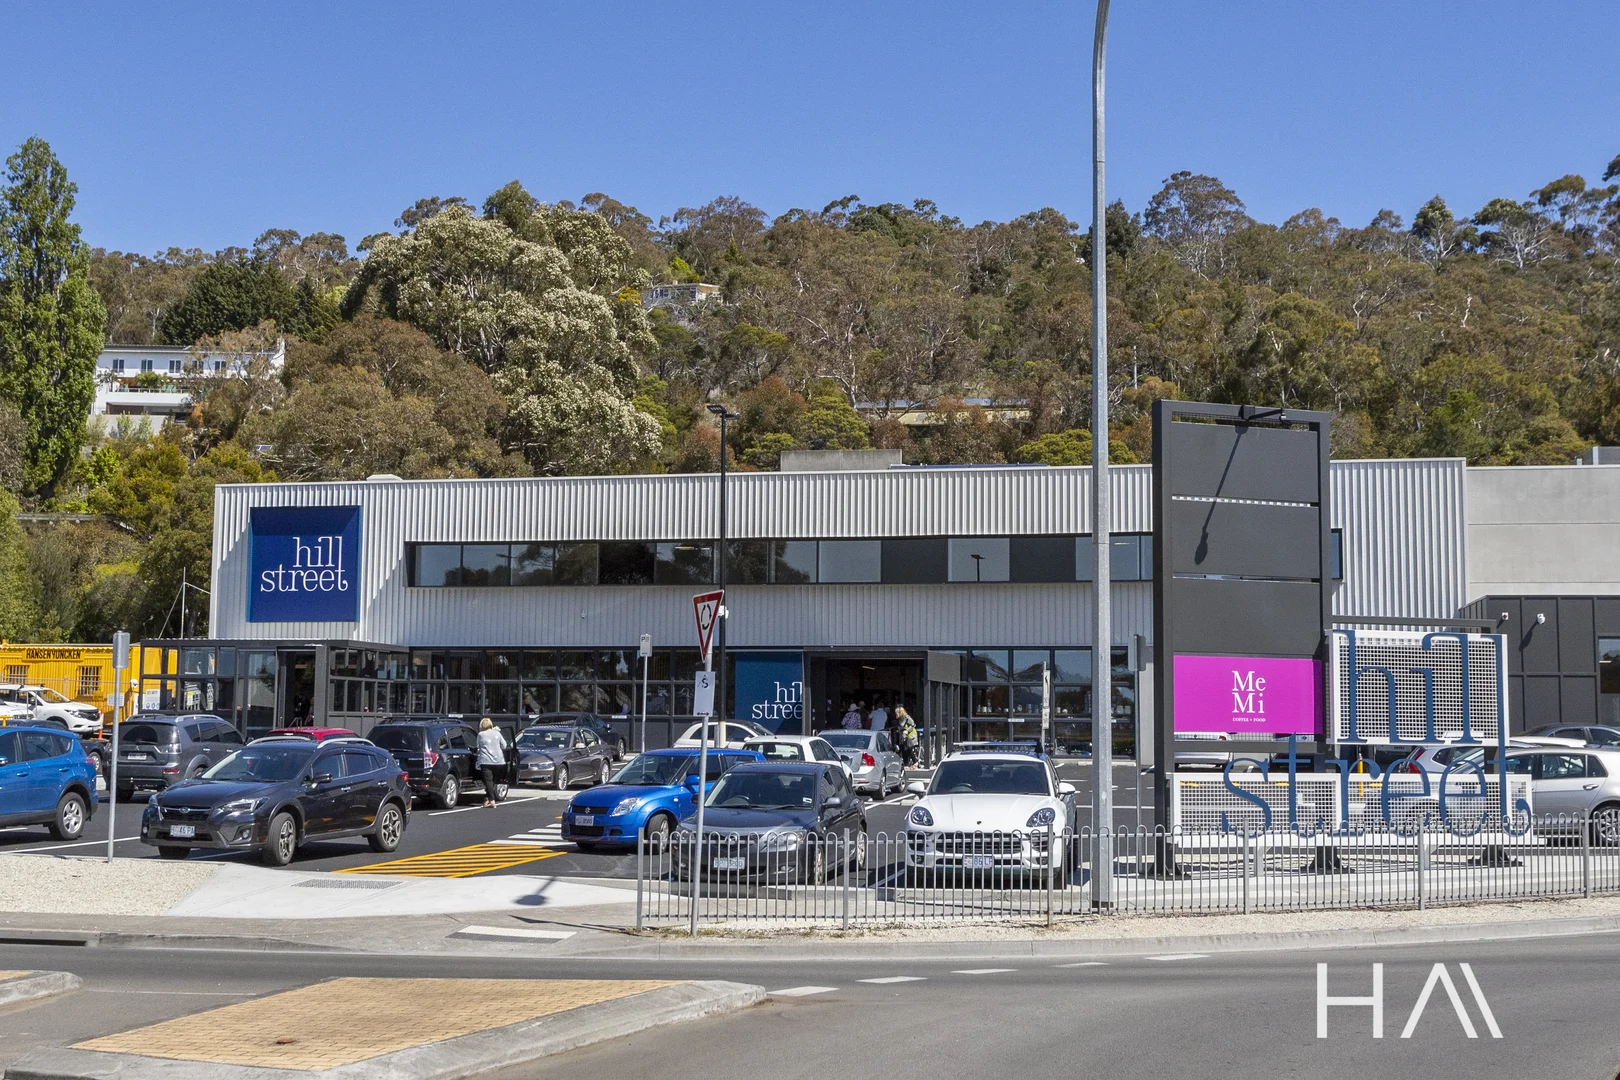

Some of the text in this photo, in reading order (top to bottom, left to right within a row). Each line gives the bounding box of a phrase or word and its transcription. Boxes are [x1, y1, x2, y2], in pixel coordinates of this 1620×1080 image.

[292, 536, 343, 567] hill
[260, 564, 348, 592] street
[26, 648, 80, 659] HANSEN YUNCKEN
[774, 681, 803, 703] hil
[1232, 670, 1266, 692] Me
[1333, 630, 1505, 744] hill
[751, 699, 804, 720] stree
[1232, 692, 1265, 713] Mi
[1221, 732, 1532, 839] street
